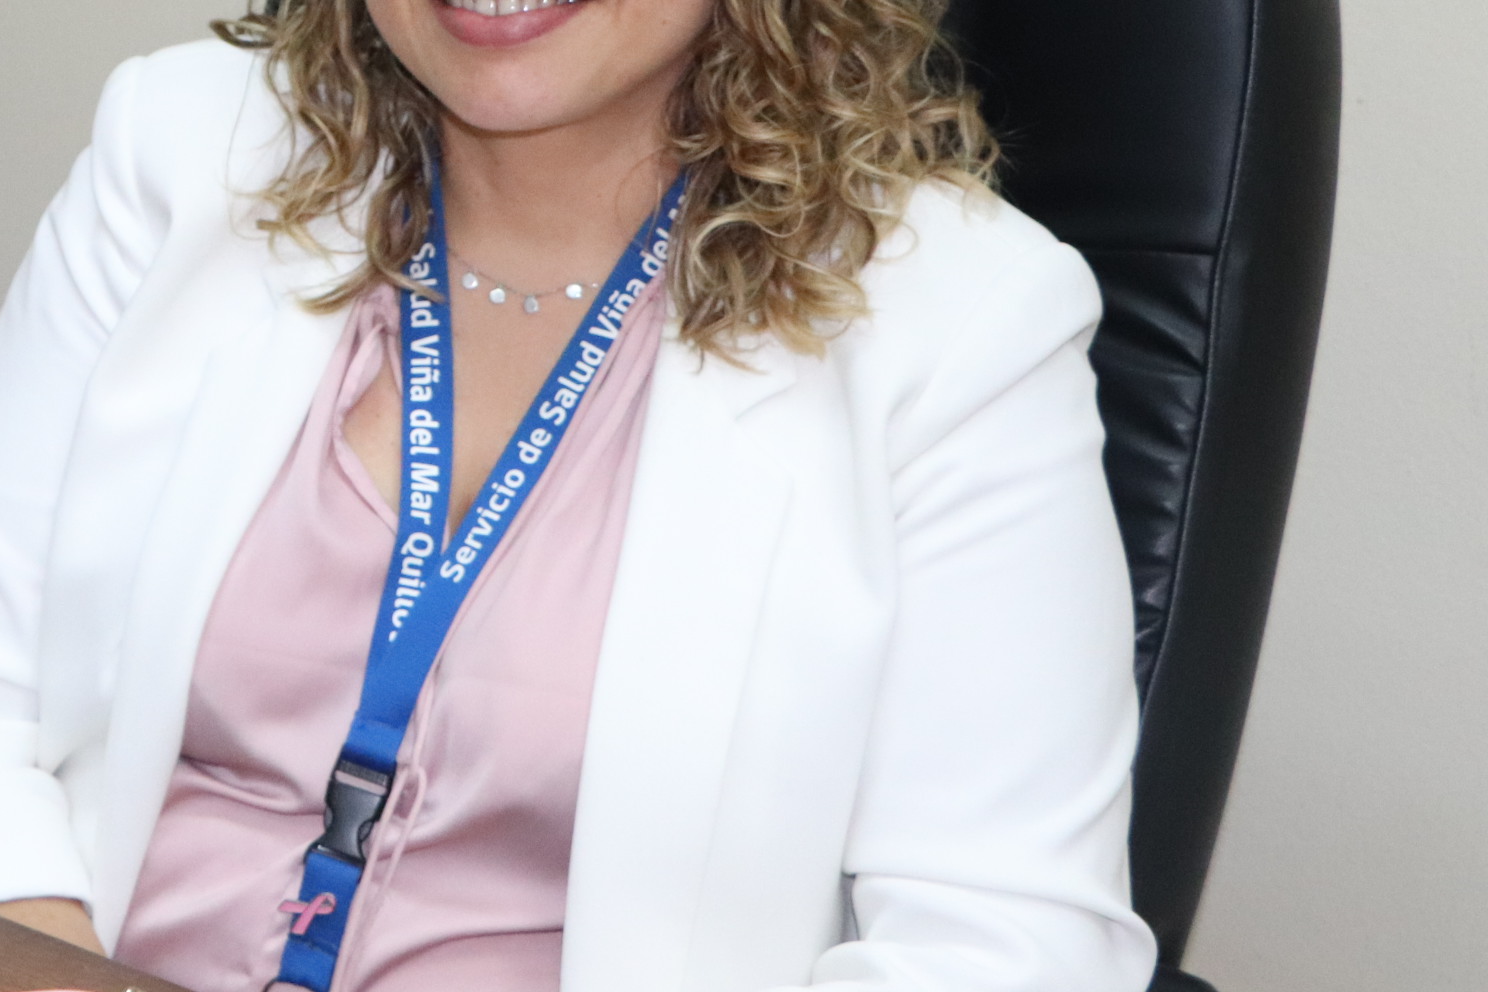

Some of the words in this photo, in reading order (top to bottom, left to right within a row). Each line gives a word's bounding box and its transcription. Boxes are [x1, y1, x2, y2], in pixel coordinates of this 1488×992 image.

[410, 242, 440, 328] Salud
[410, 334, 440, 402] Viña
[410, 409, 440, 455] del
[440, 468, 525, 583] Servicio
[517, 427, 552, 465] de
[539, 340, 605, 426] Salud
[588, 278, 646, 340] Viña
[410, 462, 440, 525] Mar
